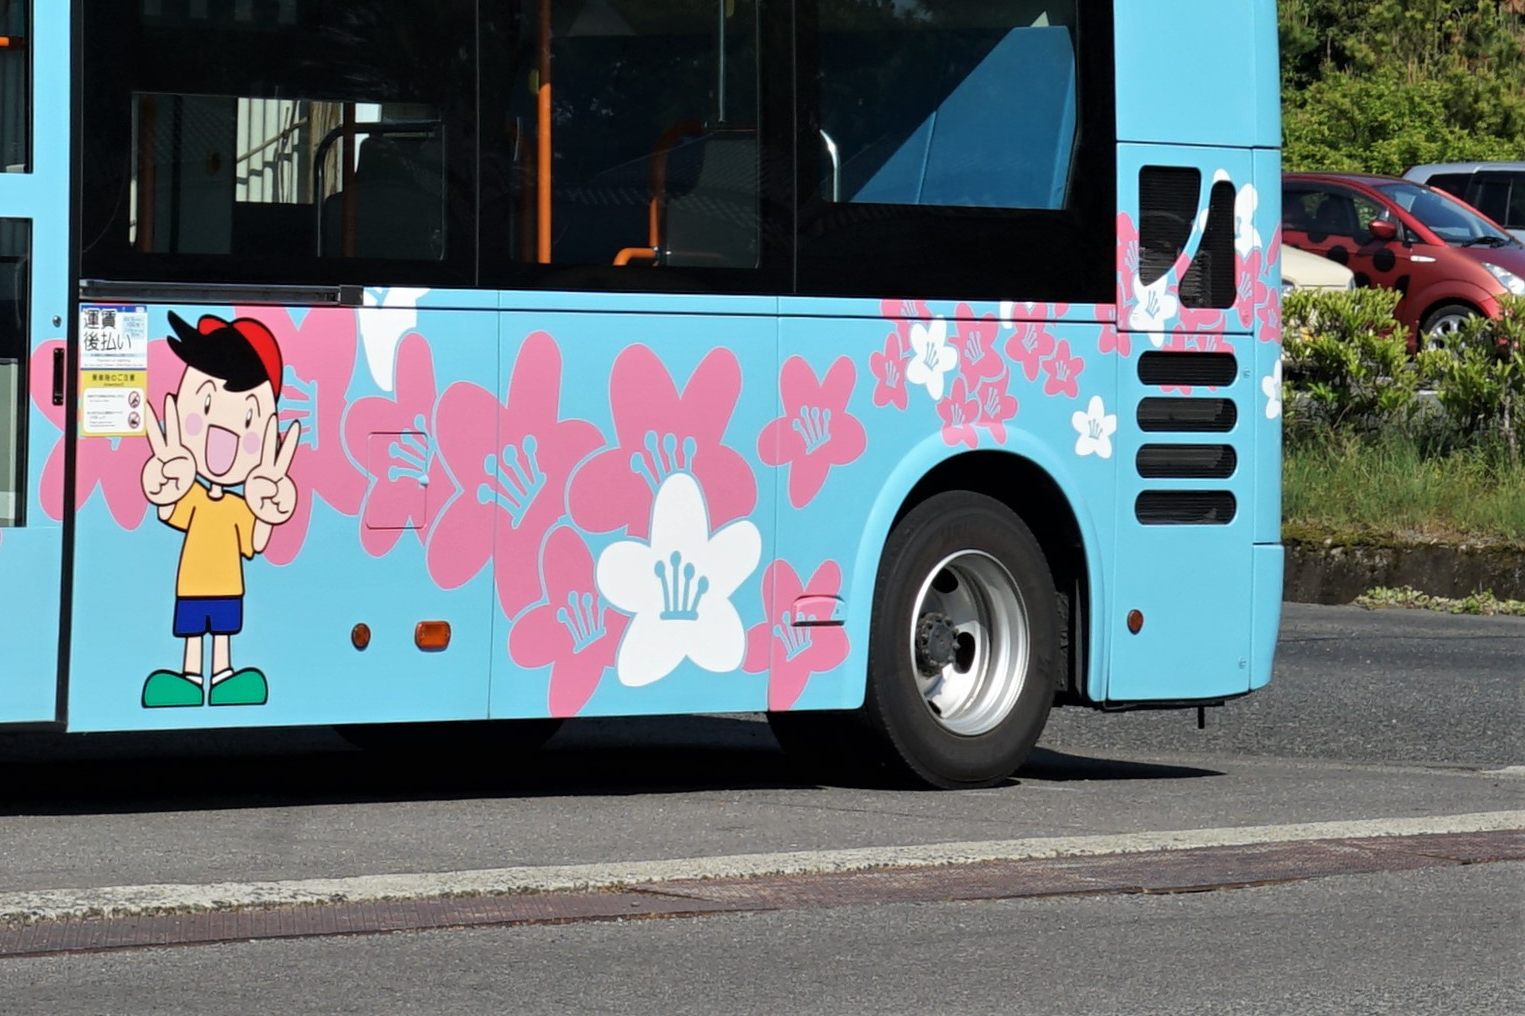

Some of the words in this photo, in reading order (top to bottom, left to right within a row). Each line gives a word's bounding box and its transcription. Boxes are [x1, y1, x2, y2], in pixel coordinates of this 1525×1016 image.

[84, 309, 116, 330] 運賃
[84, 331, 132, 351] 後払い
